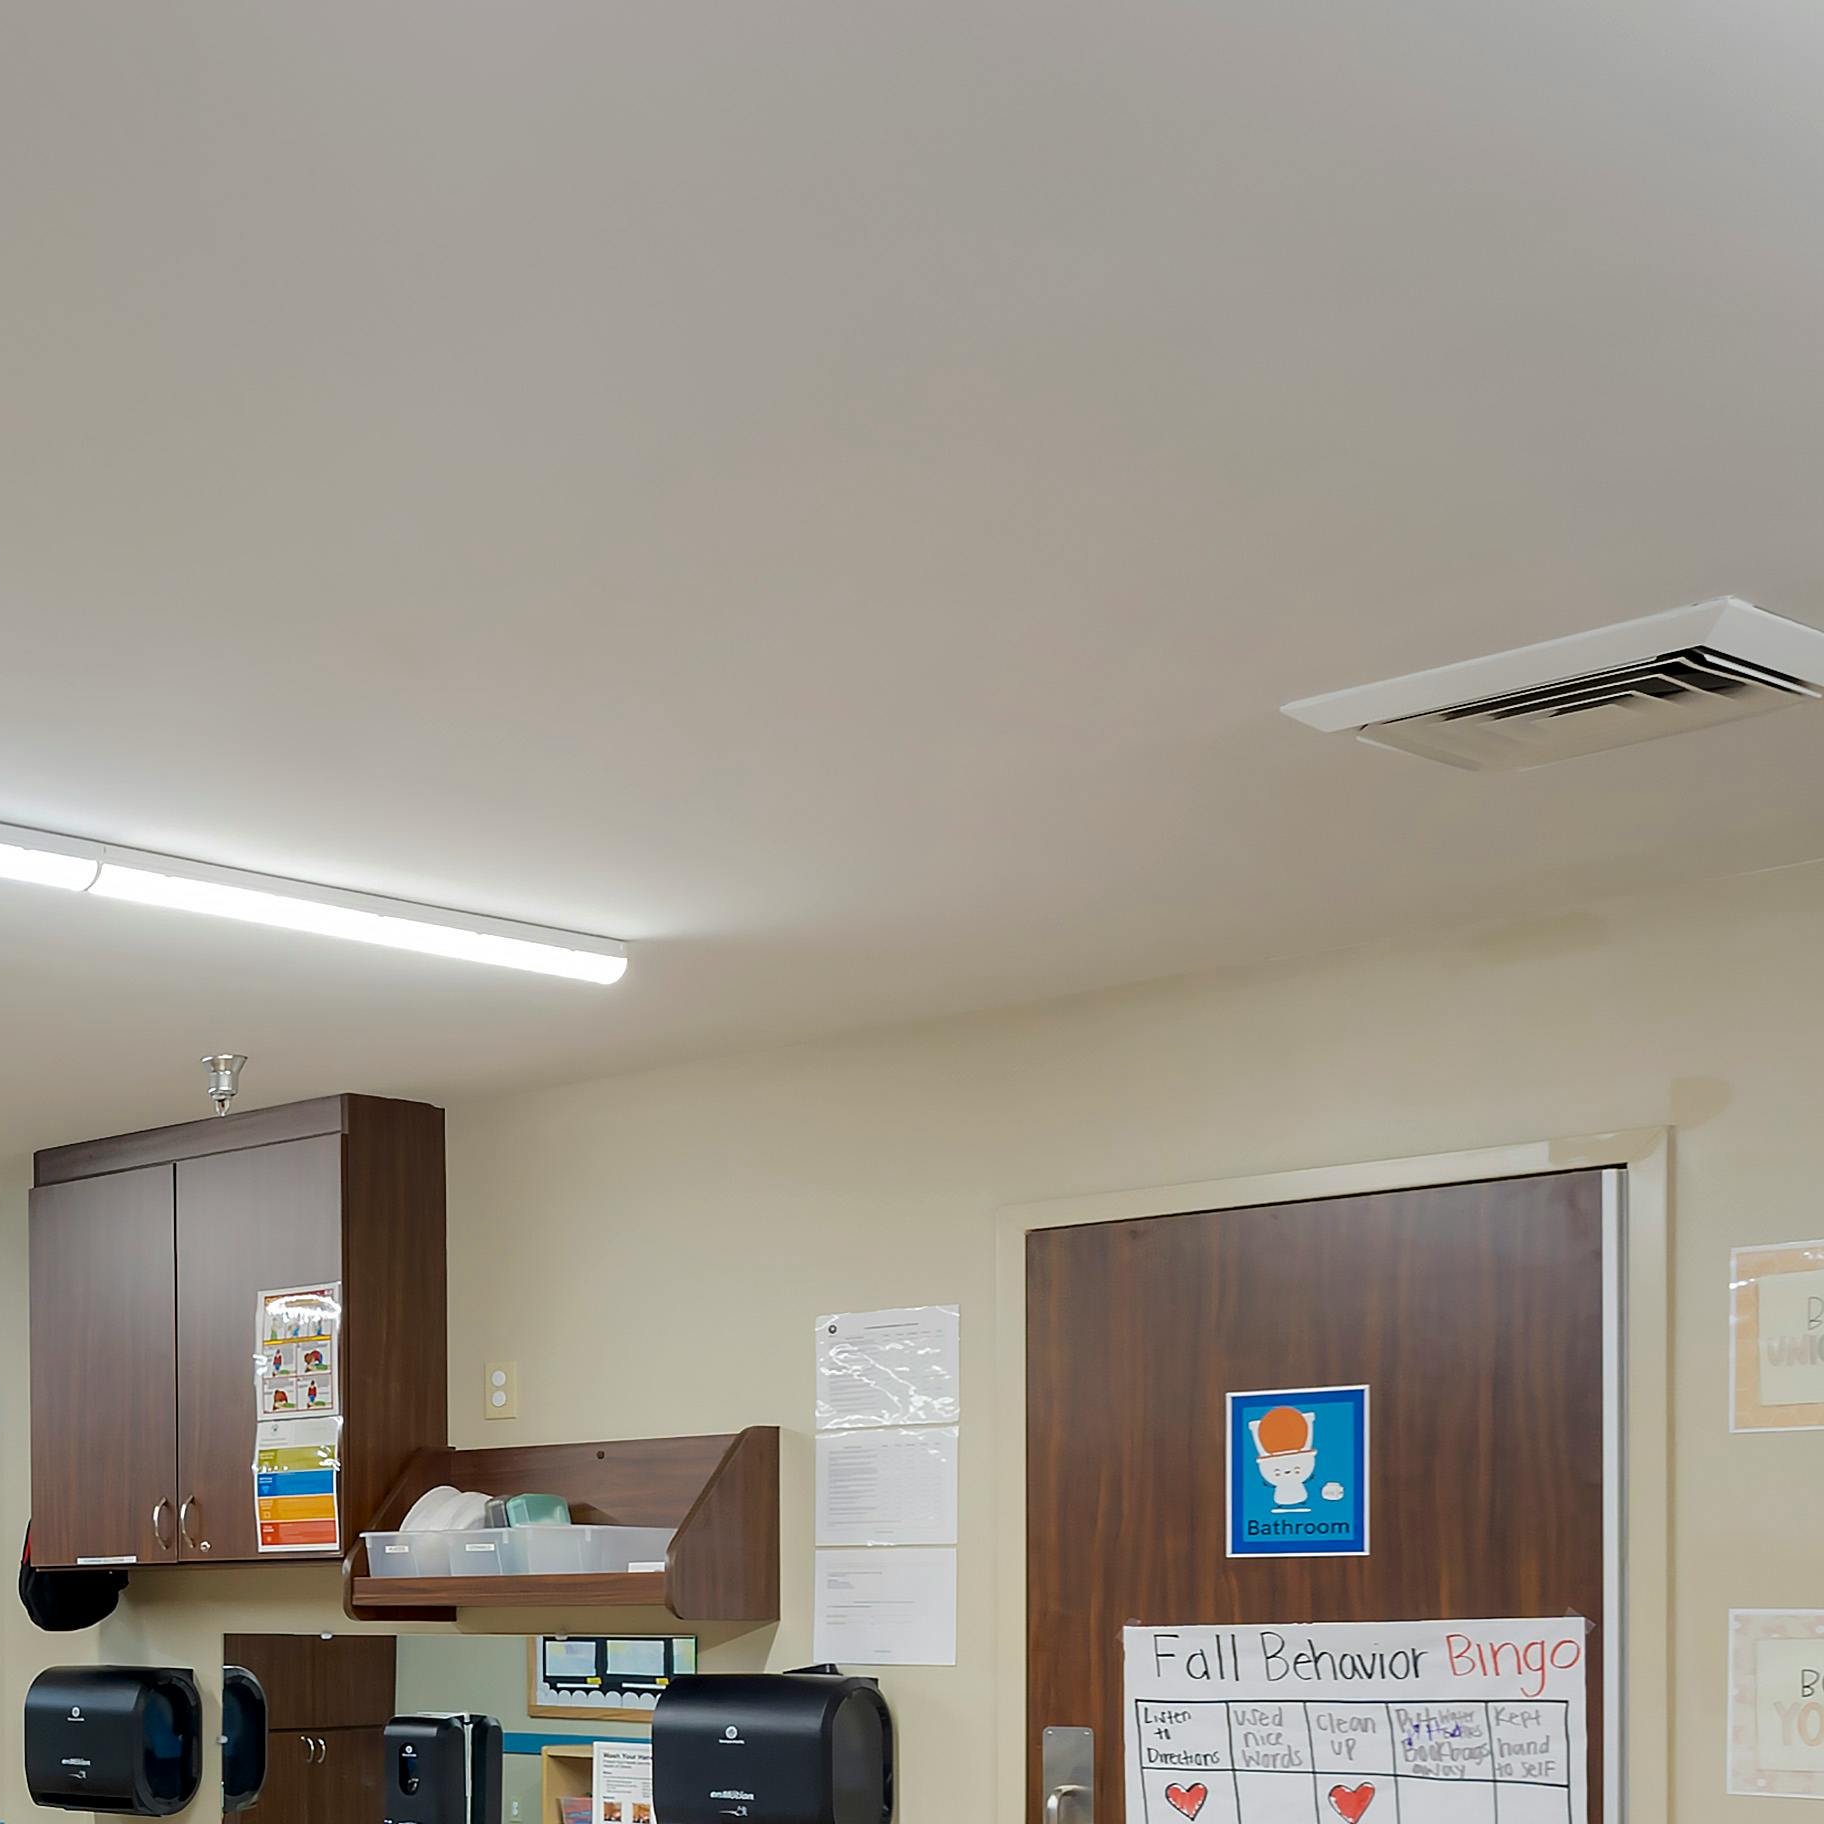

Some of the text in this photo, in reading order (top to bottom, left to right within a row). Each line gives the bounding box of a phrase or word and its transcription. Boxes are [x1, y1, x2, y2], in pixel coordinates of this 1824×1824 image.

[1248, 1520, 1350, 1536] Bathroom
[1153, 1631, 1583, 1697] Fall Behavior Bingo
[1143, 1708, 1192, 1724] Listen
[1494, 1706, 1542, 1728] Kept
[1153, 1726, 1170, 1741] to
[1243, 1731, 1284, 1747] nice
[1496, 1735, 1550, 1756] hand
[1147, 1746, 1220, 1766] Directions
